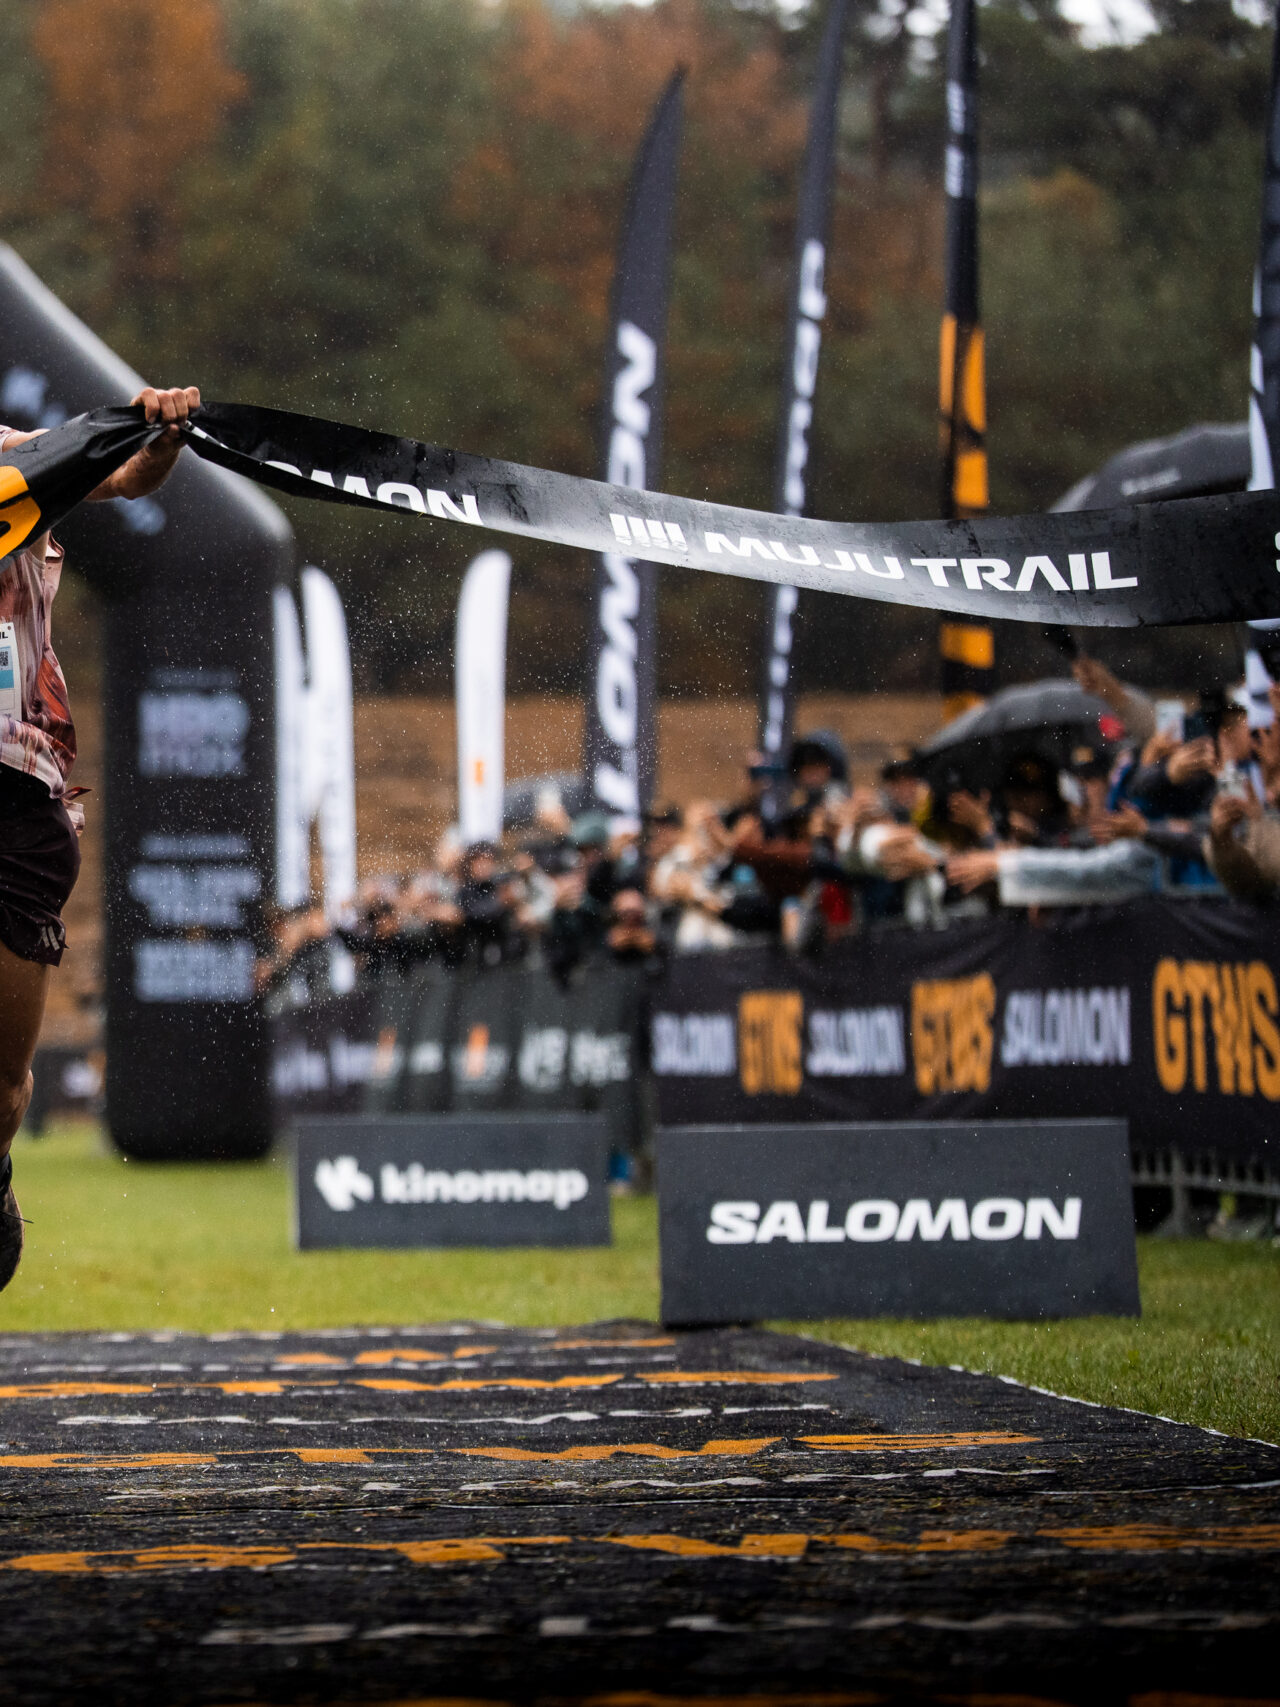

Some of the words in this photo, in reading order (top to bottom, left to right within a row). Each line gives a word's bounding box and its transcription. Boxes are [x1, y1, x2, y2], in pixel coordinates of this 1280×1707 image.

[705, 531, 905, 580] MUJU
[911, 551, 1139, 592] TRAIL
[1000, 986, 1131, 1067] SALOMON
[1152, 957, 1280, 1101] GTWS
[380, 1163, 589, 1211] kinomap
[706, 1197, 1083, 1246] SALOMON
